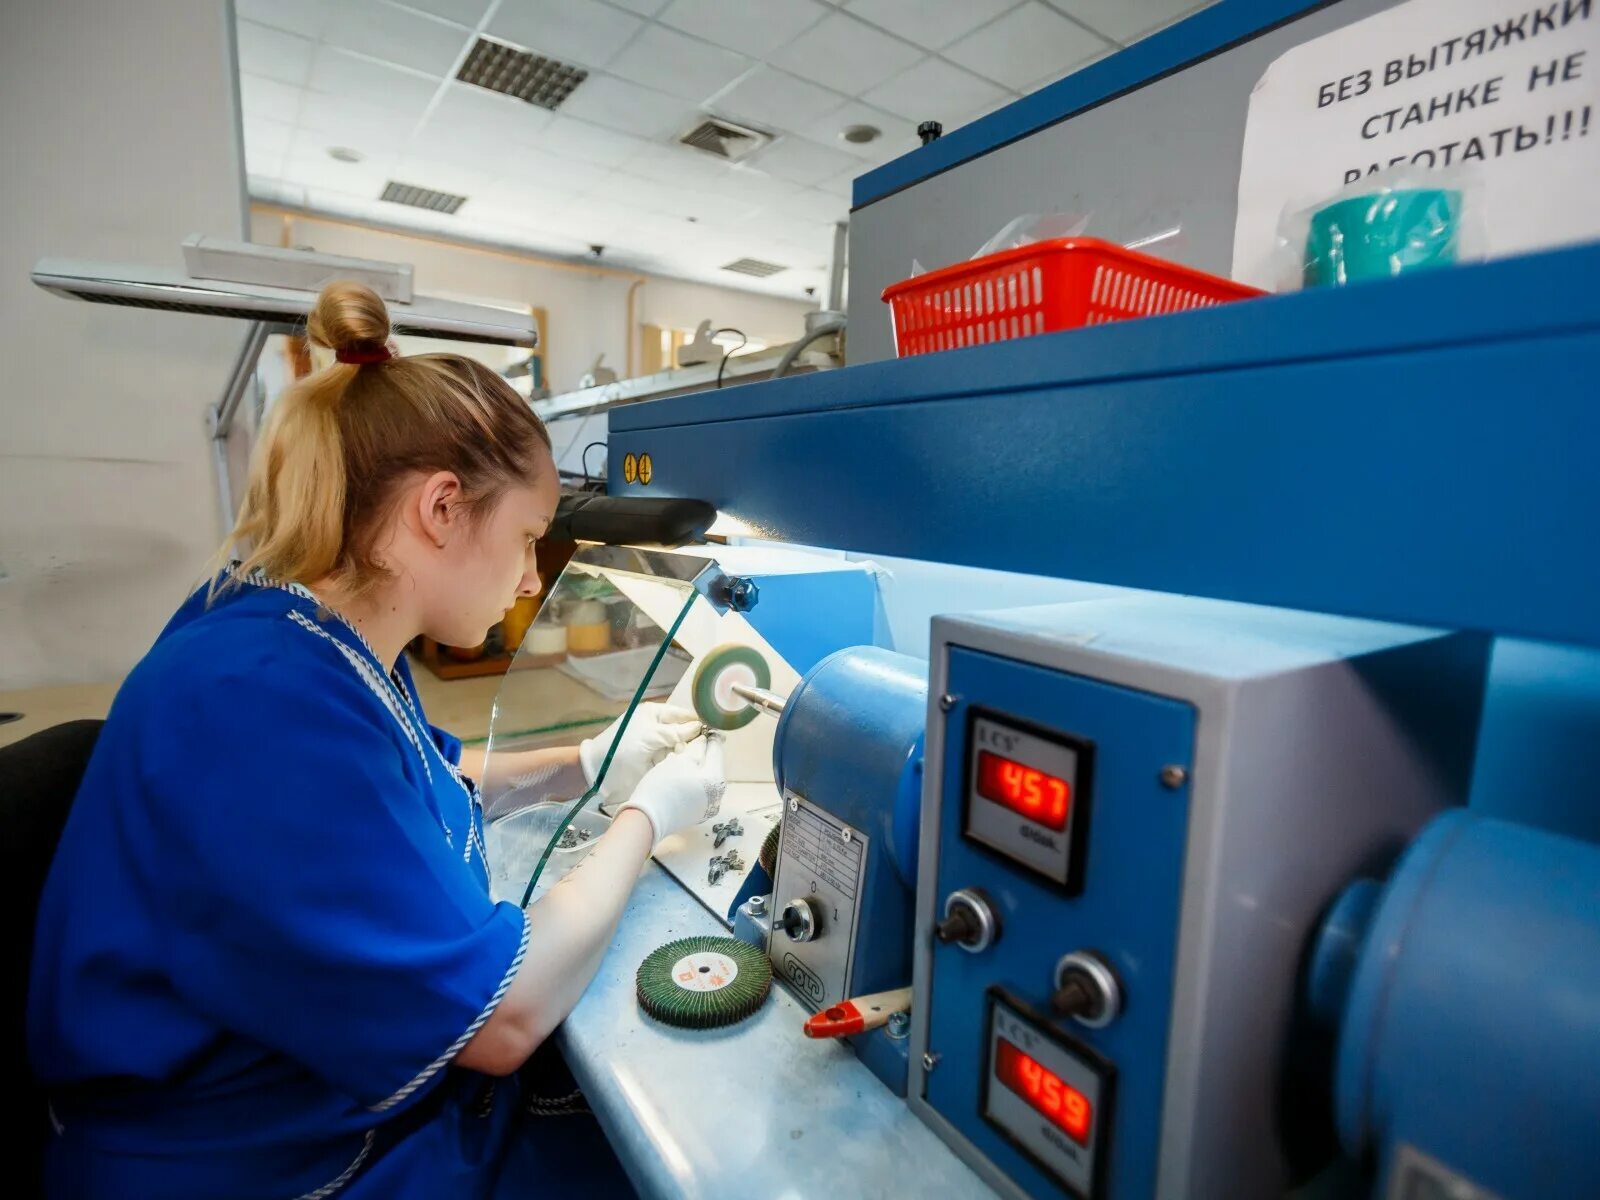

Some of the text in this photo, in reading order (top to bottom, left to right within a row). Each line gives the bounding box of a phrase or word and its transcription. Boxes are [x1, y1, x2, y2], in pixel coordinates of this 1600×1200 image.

[1317, 0, 1592, 109] БЕЗ ВЫТЯЖКИ
[1360, 51, 1587, 140] СТАНКЕ НЕ
[1002, 762, 1066, 817] 457
[1019, 1055, 1090, 1130] 459
